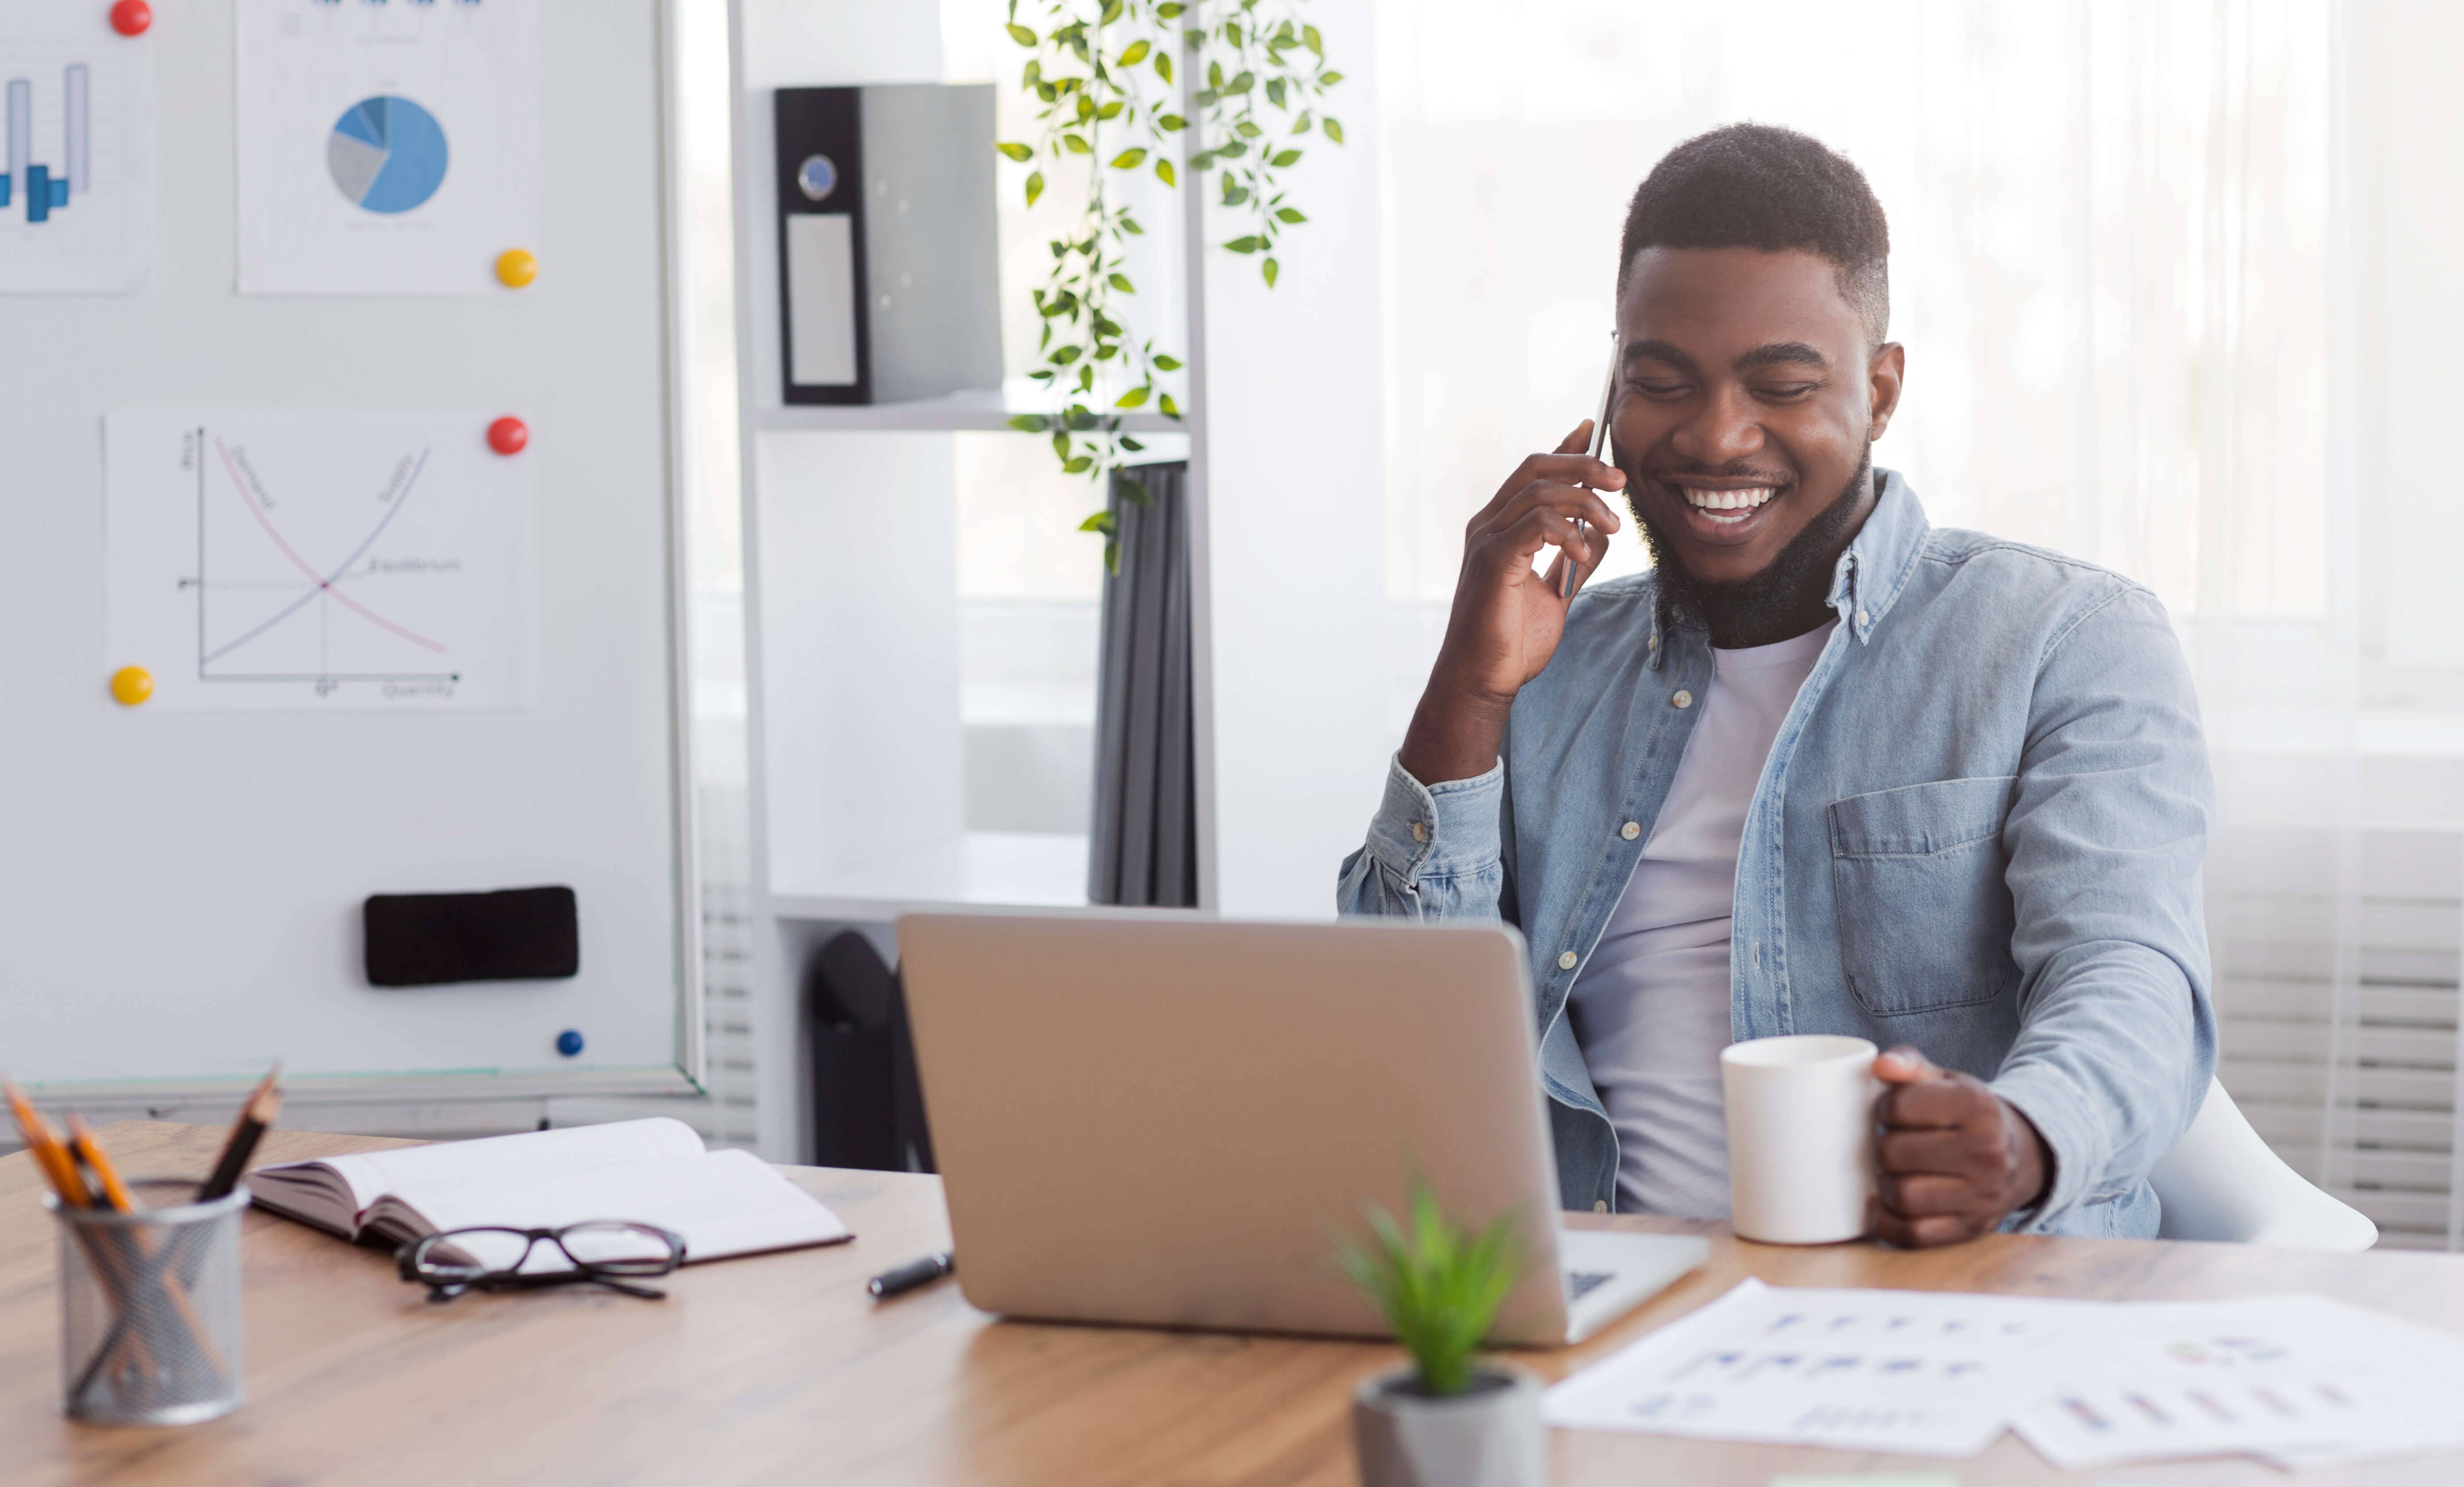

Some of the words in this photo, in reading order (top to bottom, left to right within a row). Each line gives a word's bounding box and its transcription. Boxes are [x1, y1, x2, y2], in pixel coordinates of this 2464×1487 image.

[230, 443, 275, 510] Demand
[376, 452, 413, 504] Supply
[368, 557, 463, 576] Equilibrium
[382, 682, 454, 700] Quantity
